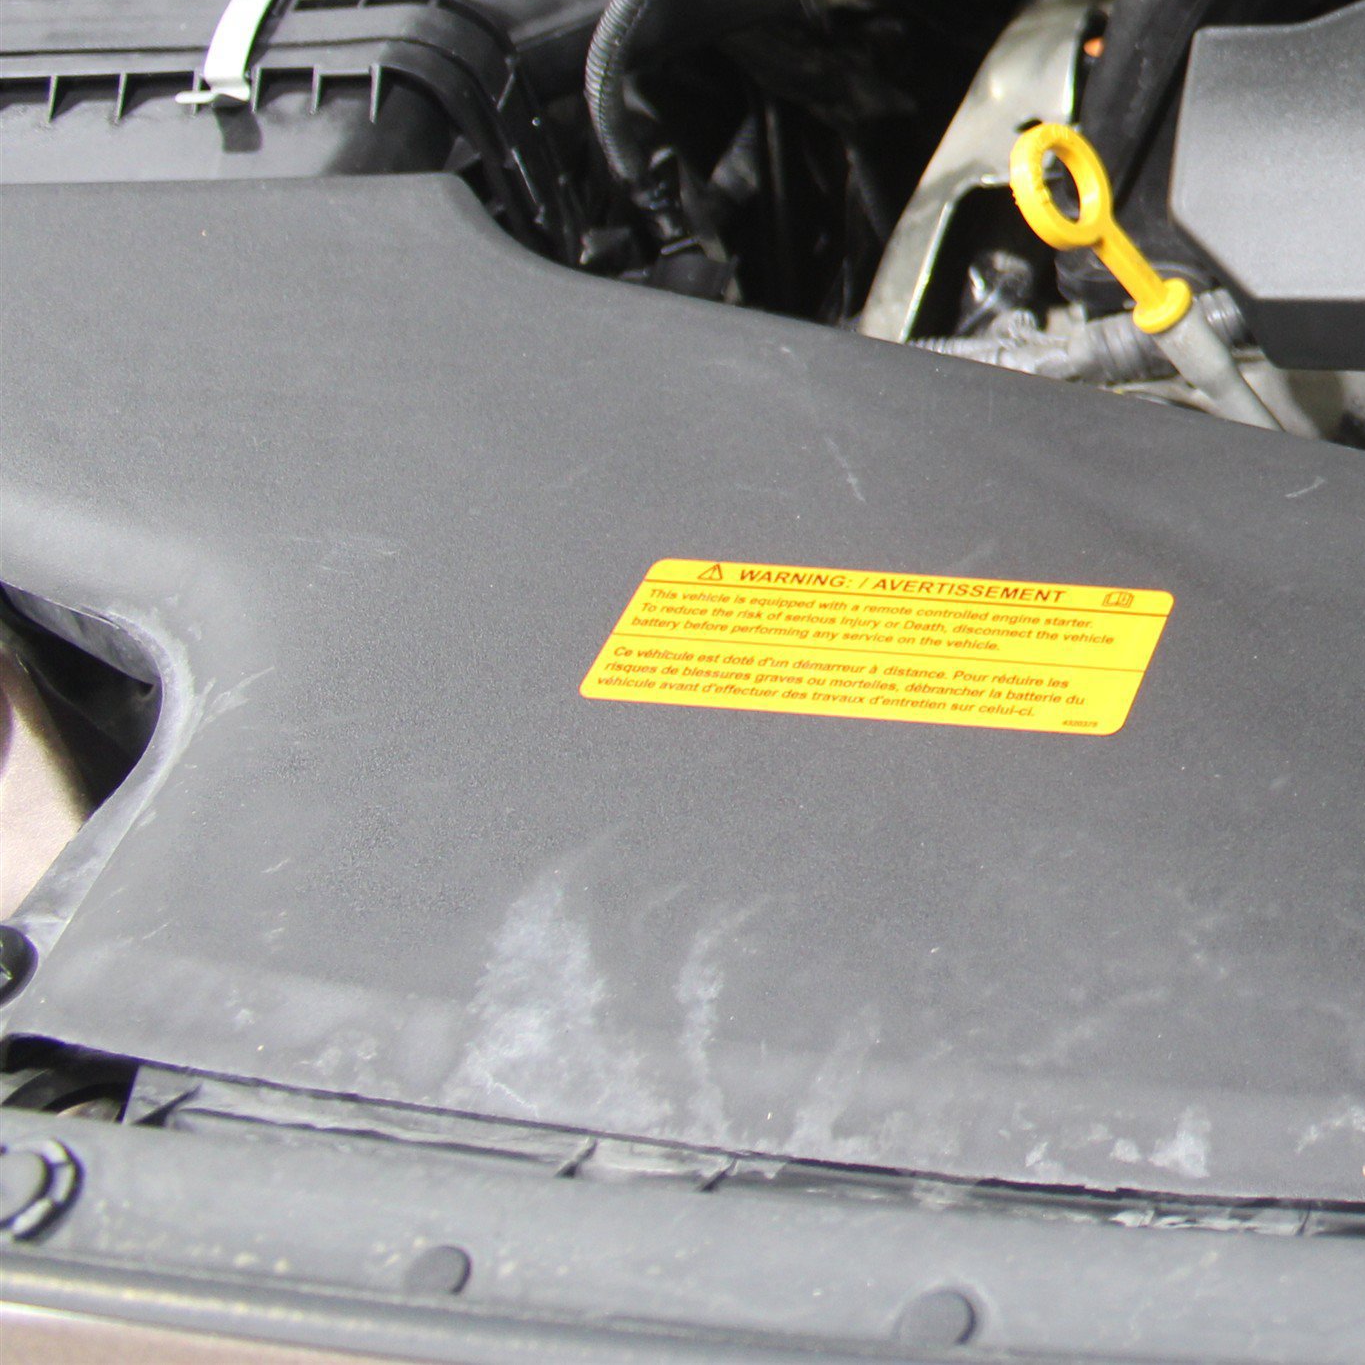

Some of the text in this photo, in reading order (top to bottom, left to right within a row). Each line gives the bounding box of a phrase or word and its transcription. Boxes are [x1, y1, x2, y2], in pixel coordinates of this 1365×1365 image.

[739, 568, 853, 588] WARNING:
[873, 578, 1067, 603] AVERTISSEMENT
[641, 603, 657, 612] To
[660, 604, 708, 616] reduce
[712, 606, 733, 617] the
[737, 609, 762, 619] risk
[767, 610, 782, 620] of
[784, 612, 836, 624] serious
[885, 622, 900, 630] or
[904, 620, 946, 634] Death,
[952, 624, 1032, 639] disconnect
[1037, 630, 1058, 641] the
[1063, 633, 1114, 645] vehicle
[650, 589, 678, 599] This
[682, 591, 730, 604] vehicle
[735, 594, 746, 604] is
[750, 596, 815, 611] equipped
[819, 599, 846, 611] with
[864, 604, 912, 616] remote
[917, 607, 988, 621] controlled
[992, 613, 1040, 626] engine
[631, 617, 1000, 651] battery before performing any service on the vehicle.
[604, 662, 1085, 706] risques de blessures graves ou mortelles, débrancher la batterie du
[614, 646, 632, 657] Ce
[637, 648, 694, 662] véhicule
[697, 654, 719, 663] est
[723, 655, 755, 667] doté
[758, 657, 788, 669] d'un
[792, 659, 866, 674] démarreur
[884, 666, 948, 680] distance.
[952, 671, 988, 683] Pour
[992, 674, 1044, 687] réduire
[1048, 678, 1069, 689] les
[597, 676, 1034, 717] véhicule avant d'effectuer des travaux d'entretien sur celui-ci.
